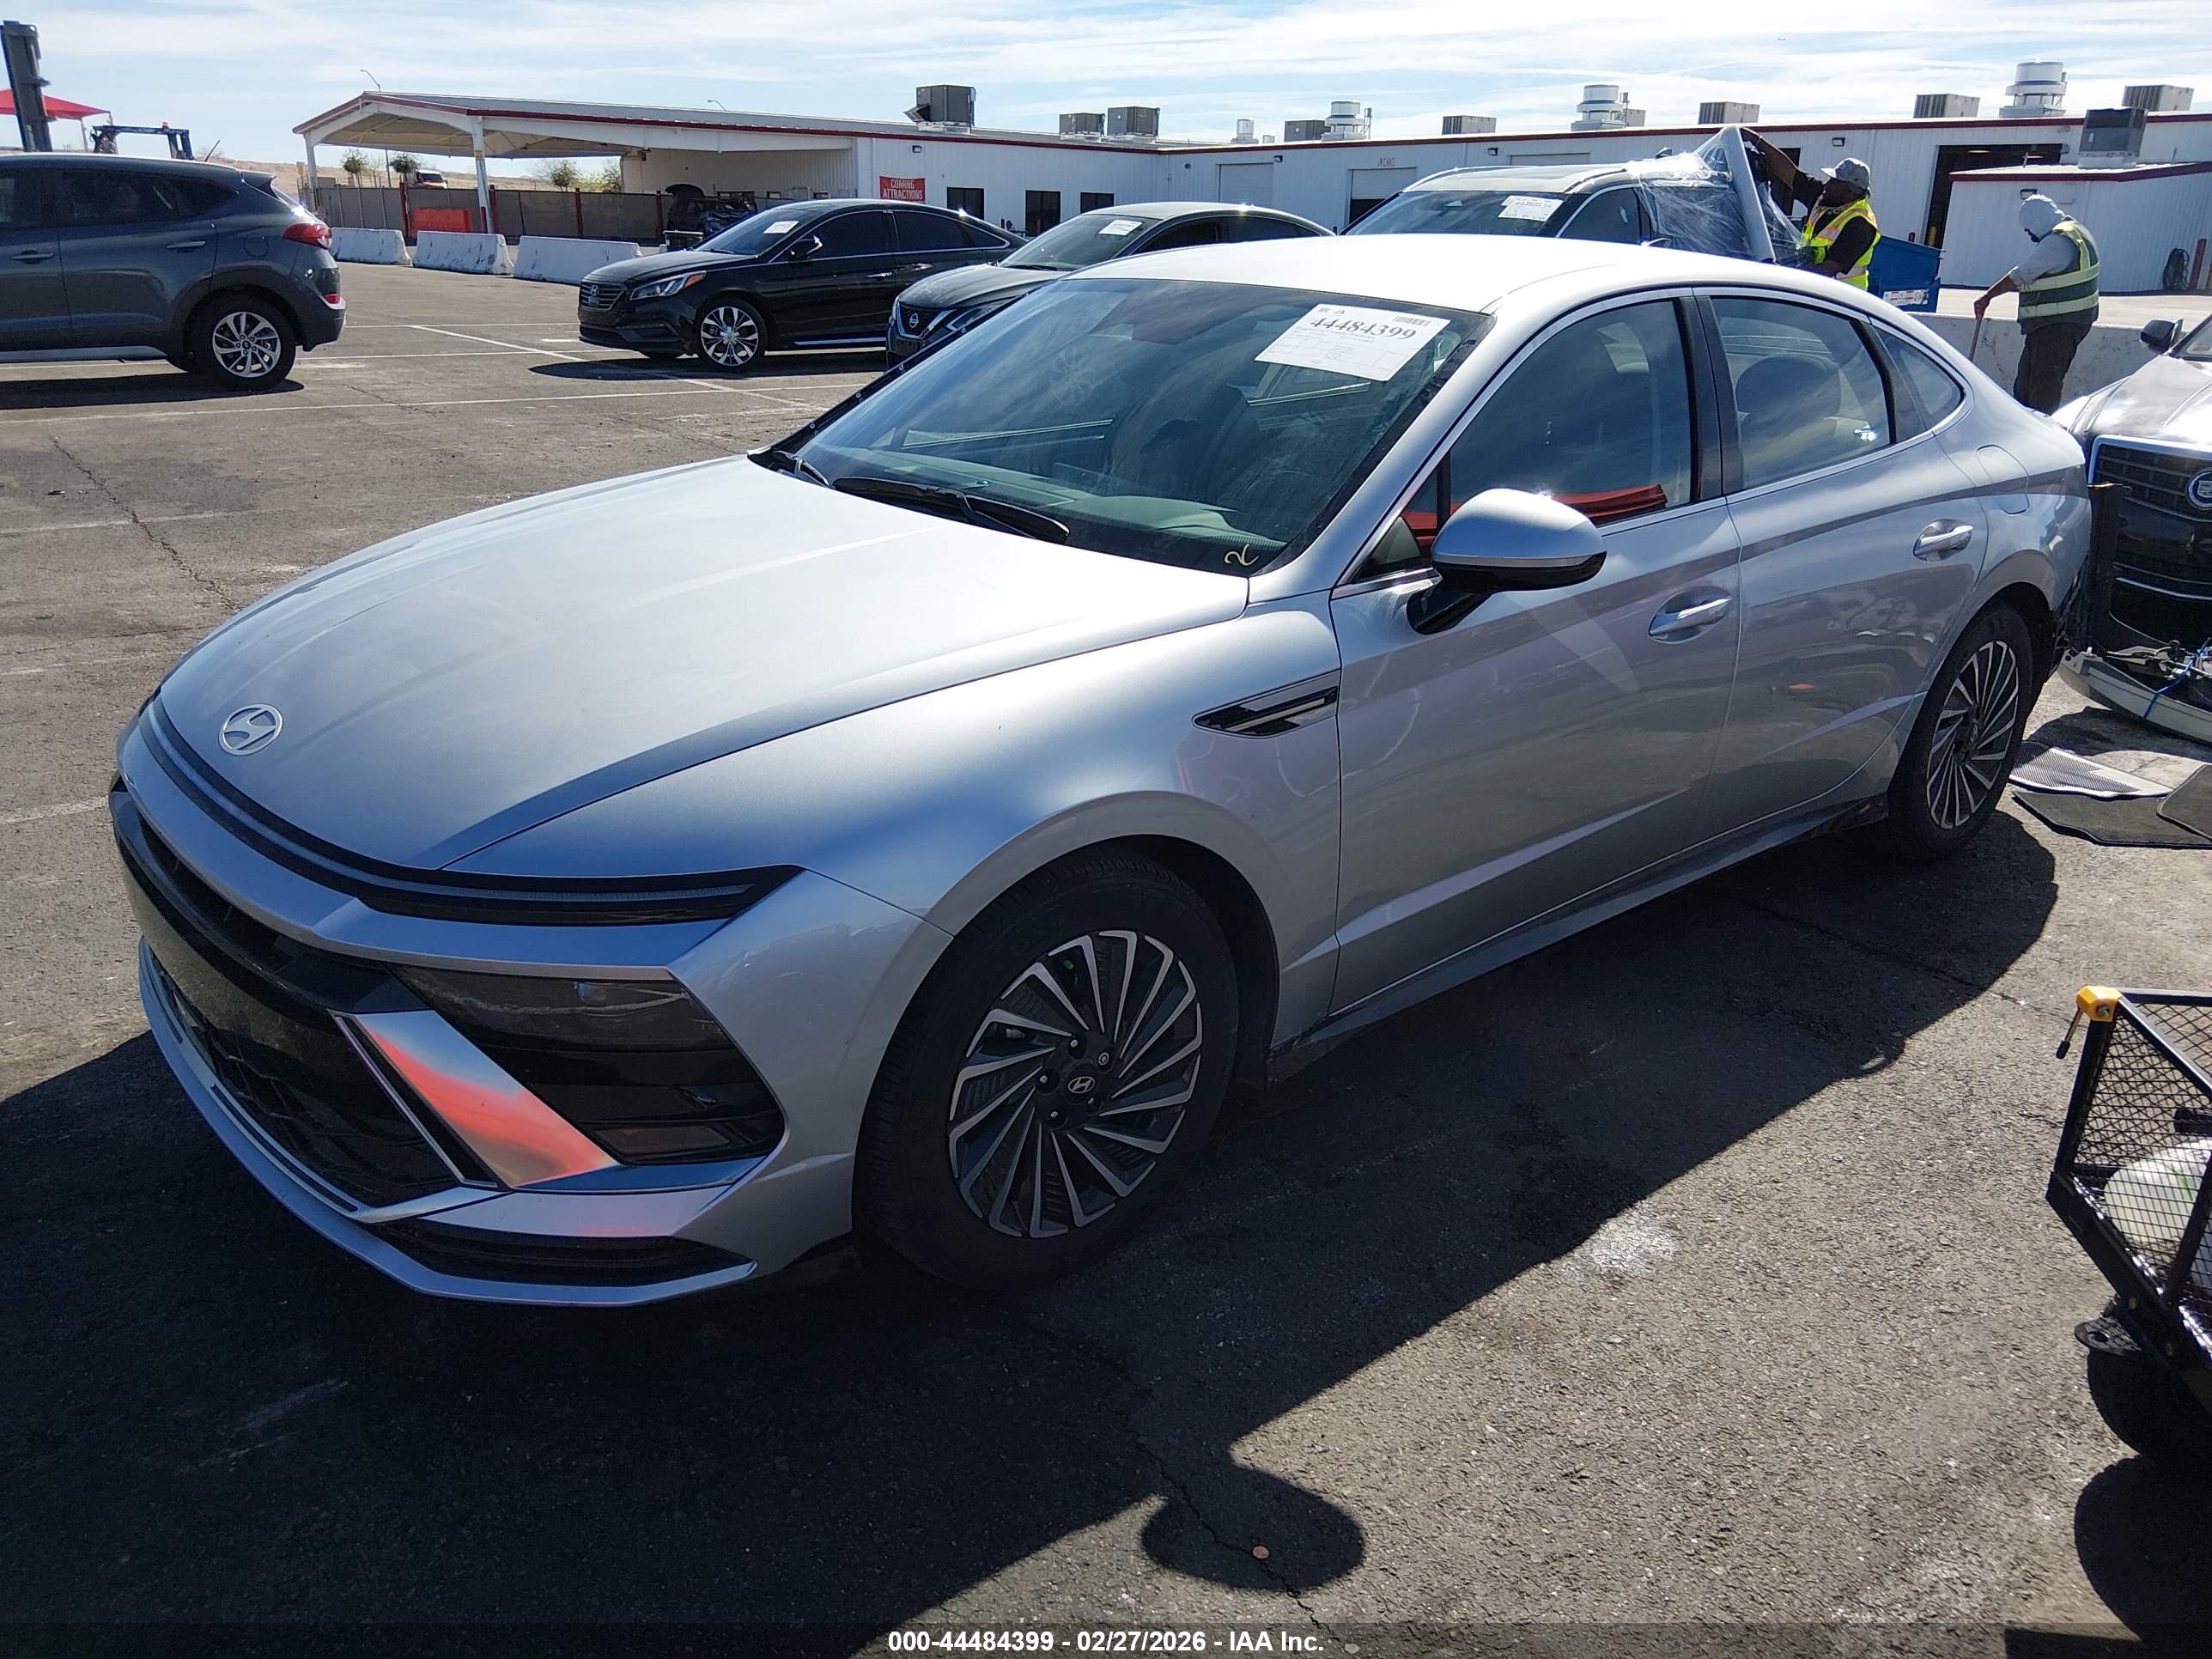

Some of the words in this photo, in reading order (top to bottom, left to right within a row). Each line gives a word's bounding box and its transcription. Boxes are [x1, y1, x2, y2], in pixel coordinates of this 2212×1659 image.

[890, 179, 915, 189] COMING
[883, 188, 923, 200] ATTRACTIONS
[1310, 317, 1417, 340] 44484399
